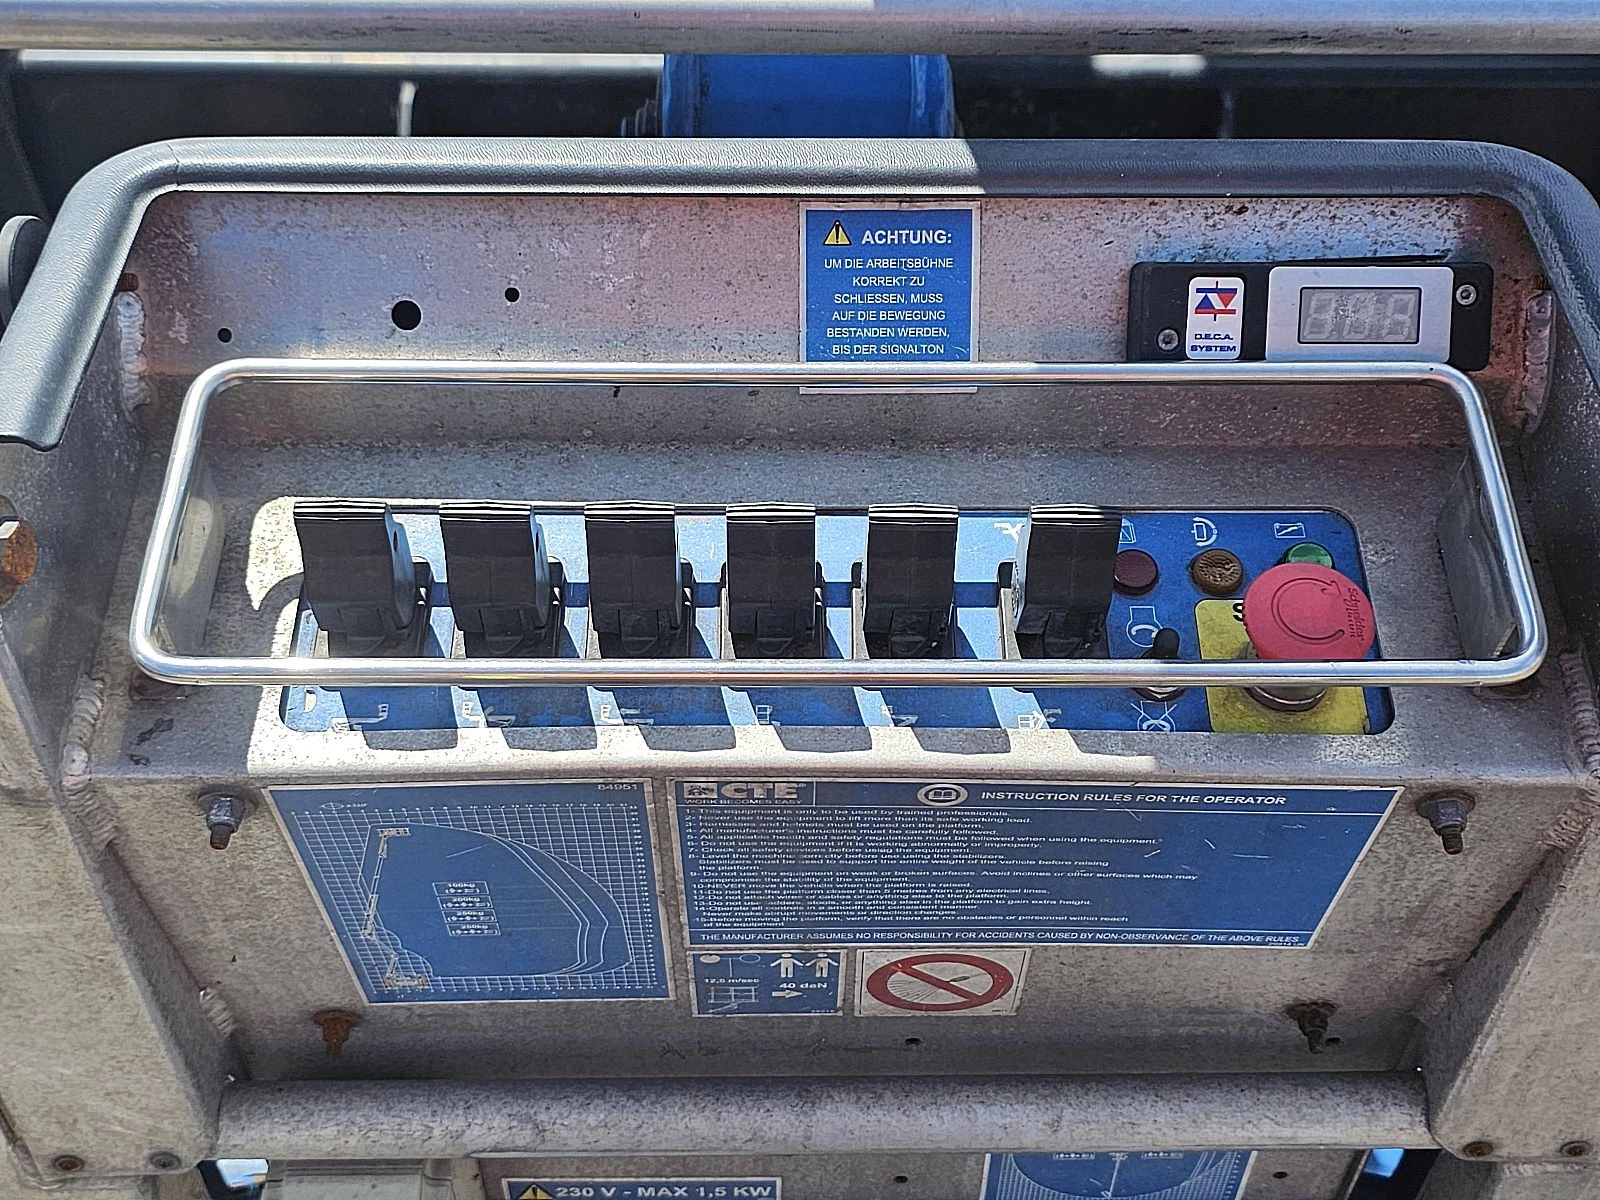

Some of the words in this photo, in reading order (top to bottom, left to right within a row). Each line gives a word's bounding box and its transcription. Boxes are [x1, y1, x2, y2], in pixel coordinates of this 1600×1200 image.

[861, 230, 952, 244] ACHTUNG:
[824, 258, 842, 269] UM
[845, 258, 864, 269] DIE
[866, 257, 953, 269] ARBEITSBÜHNE
[852, 276, 907, 287] KORREKT
[909, 276, 925, 287] ZU
[834, 293, 908, 305] SCHLIESSEN,
[910, 293, 943, 304] MUSS
[832, 311, 855, 321] AUF
[857, 311, 876, 321] DIE
[879, 310, 946, 321] BEWEGUNG
[826, 327, 895, 338] BESTANDEN
[897, 327, 950, 339] WERDEN,
[832, 344, 850, 355] BIS
[853, 344, 878, 355] DER
[879, 344, 944, 355] SIGNALTON
[720, 782, 798, 799] CTE
[981, 792, 1080, 800] INSTRUCTION
[1082, 793, 1132, 802] RULES
[1136, 794, 1167, 802] FOR
[1171, 795, 1200, 803] THE
[1203, 796, 1287, 804] OPERATOR
[555, 1187, 595, 1197] 230
[600, 1187, 616, 1197] V
[637, 1187, 688, 1197] MAX
[696, 1187, 727, 1198] 1,5
[734, 1186, 772, 1197] KW
